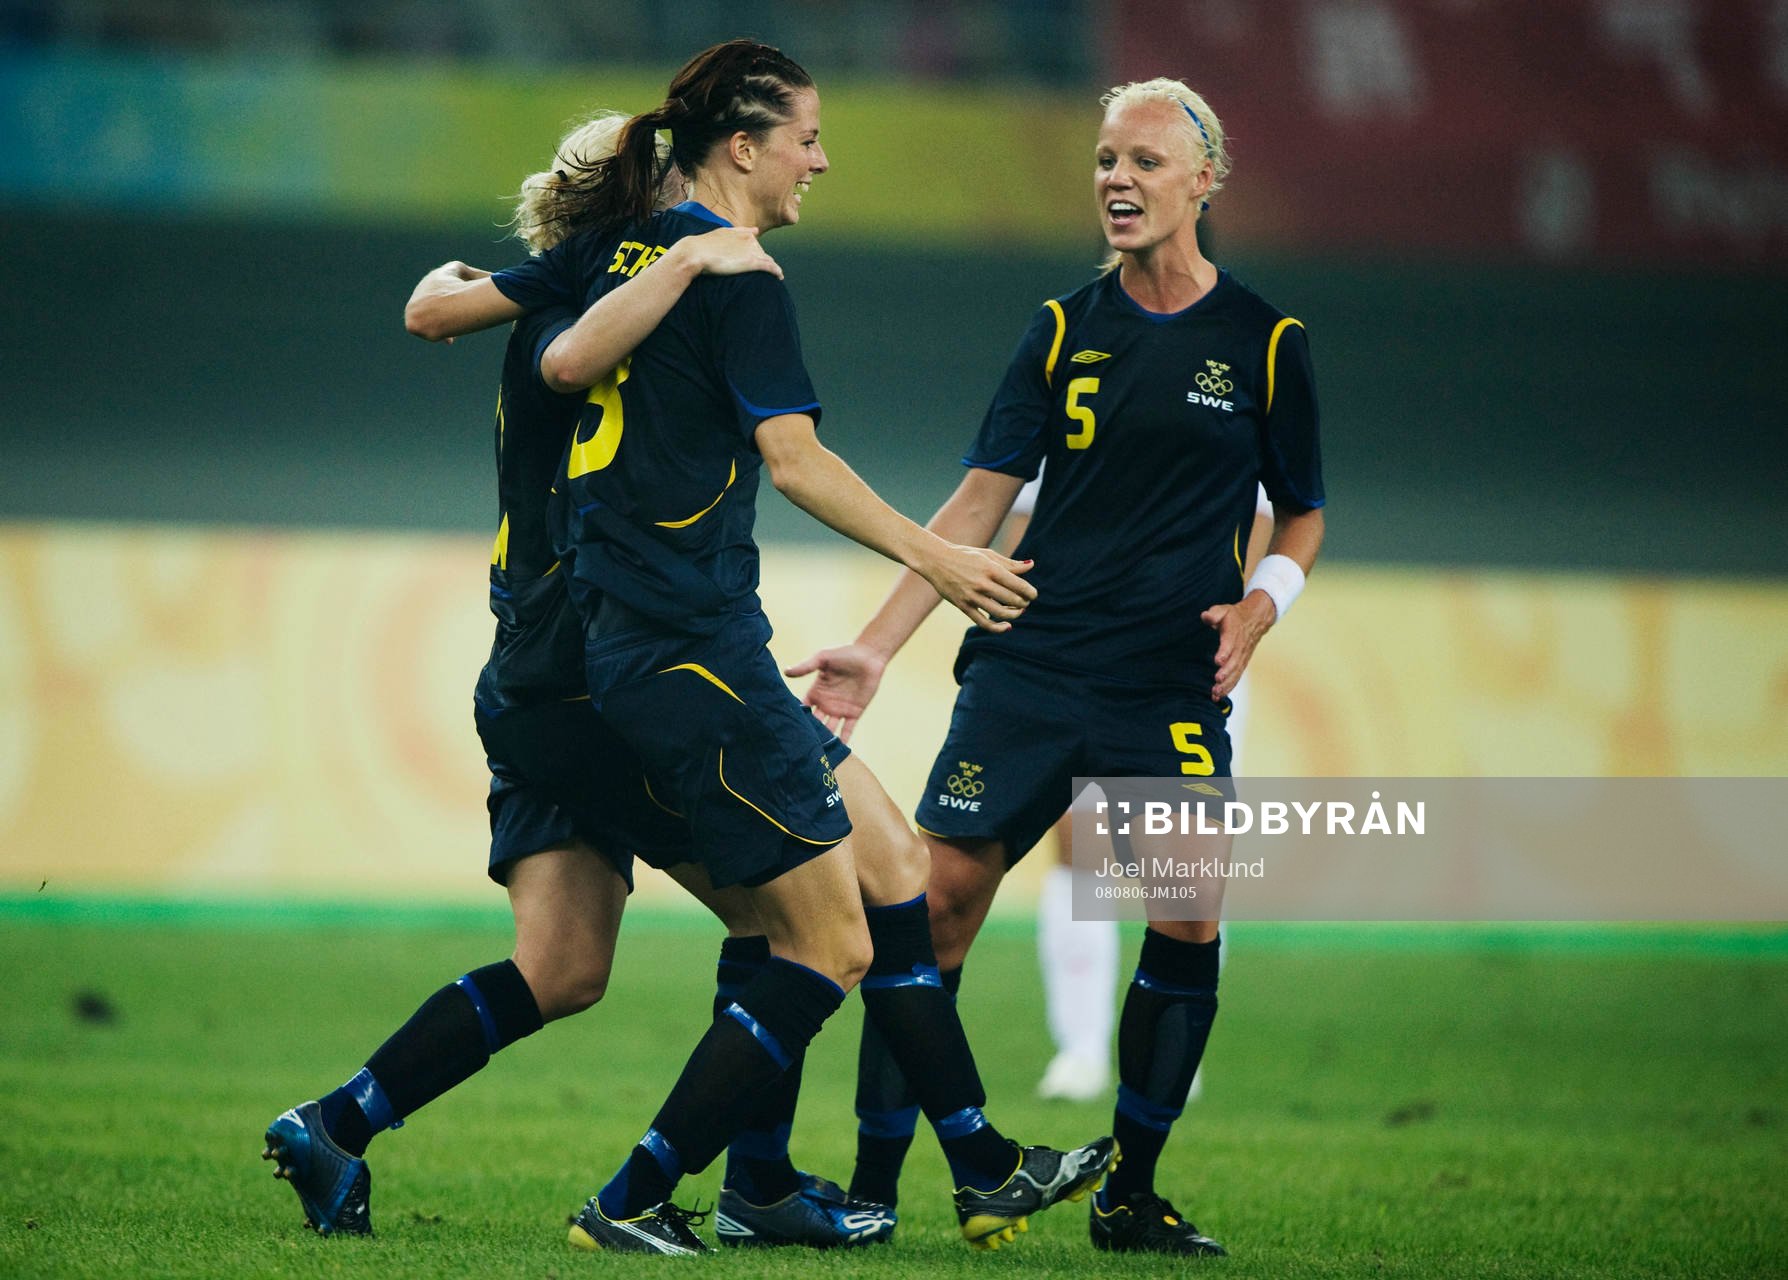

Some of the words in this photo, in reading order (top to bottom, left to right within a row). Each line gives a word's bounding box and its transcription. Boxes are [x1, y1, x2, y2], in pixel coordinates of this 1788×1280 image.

[1186, 391, 1235, 412] SWE
[1065, 377, 1100, 450] 5
[1168, 721, 1215, 776] 5
[826, 789, 842, 808] SW
[938, 794, 982, 813] SWE
